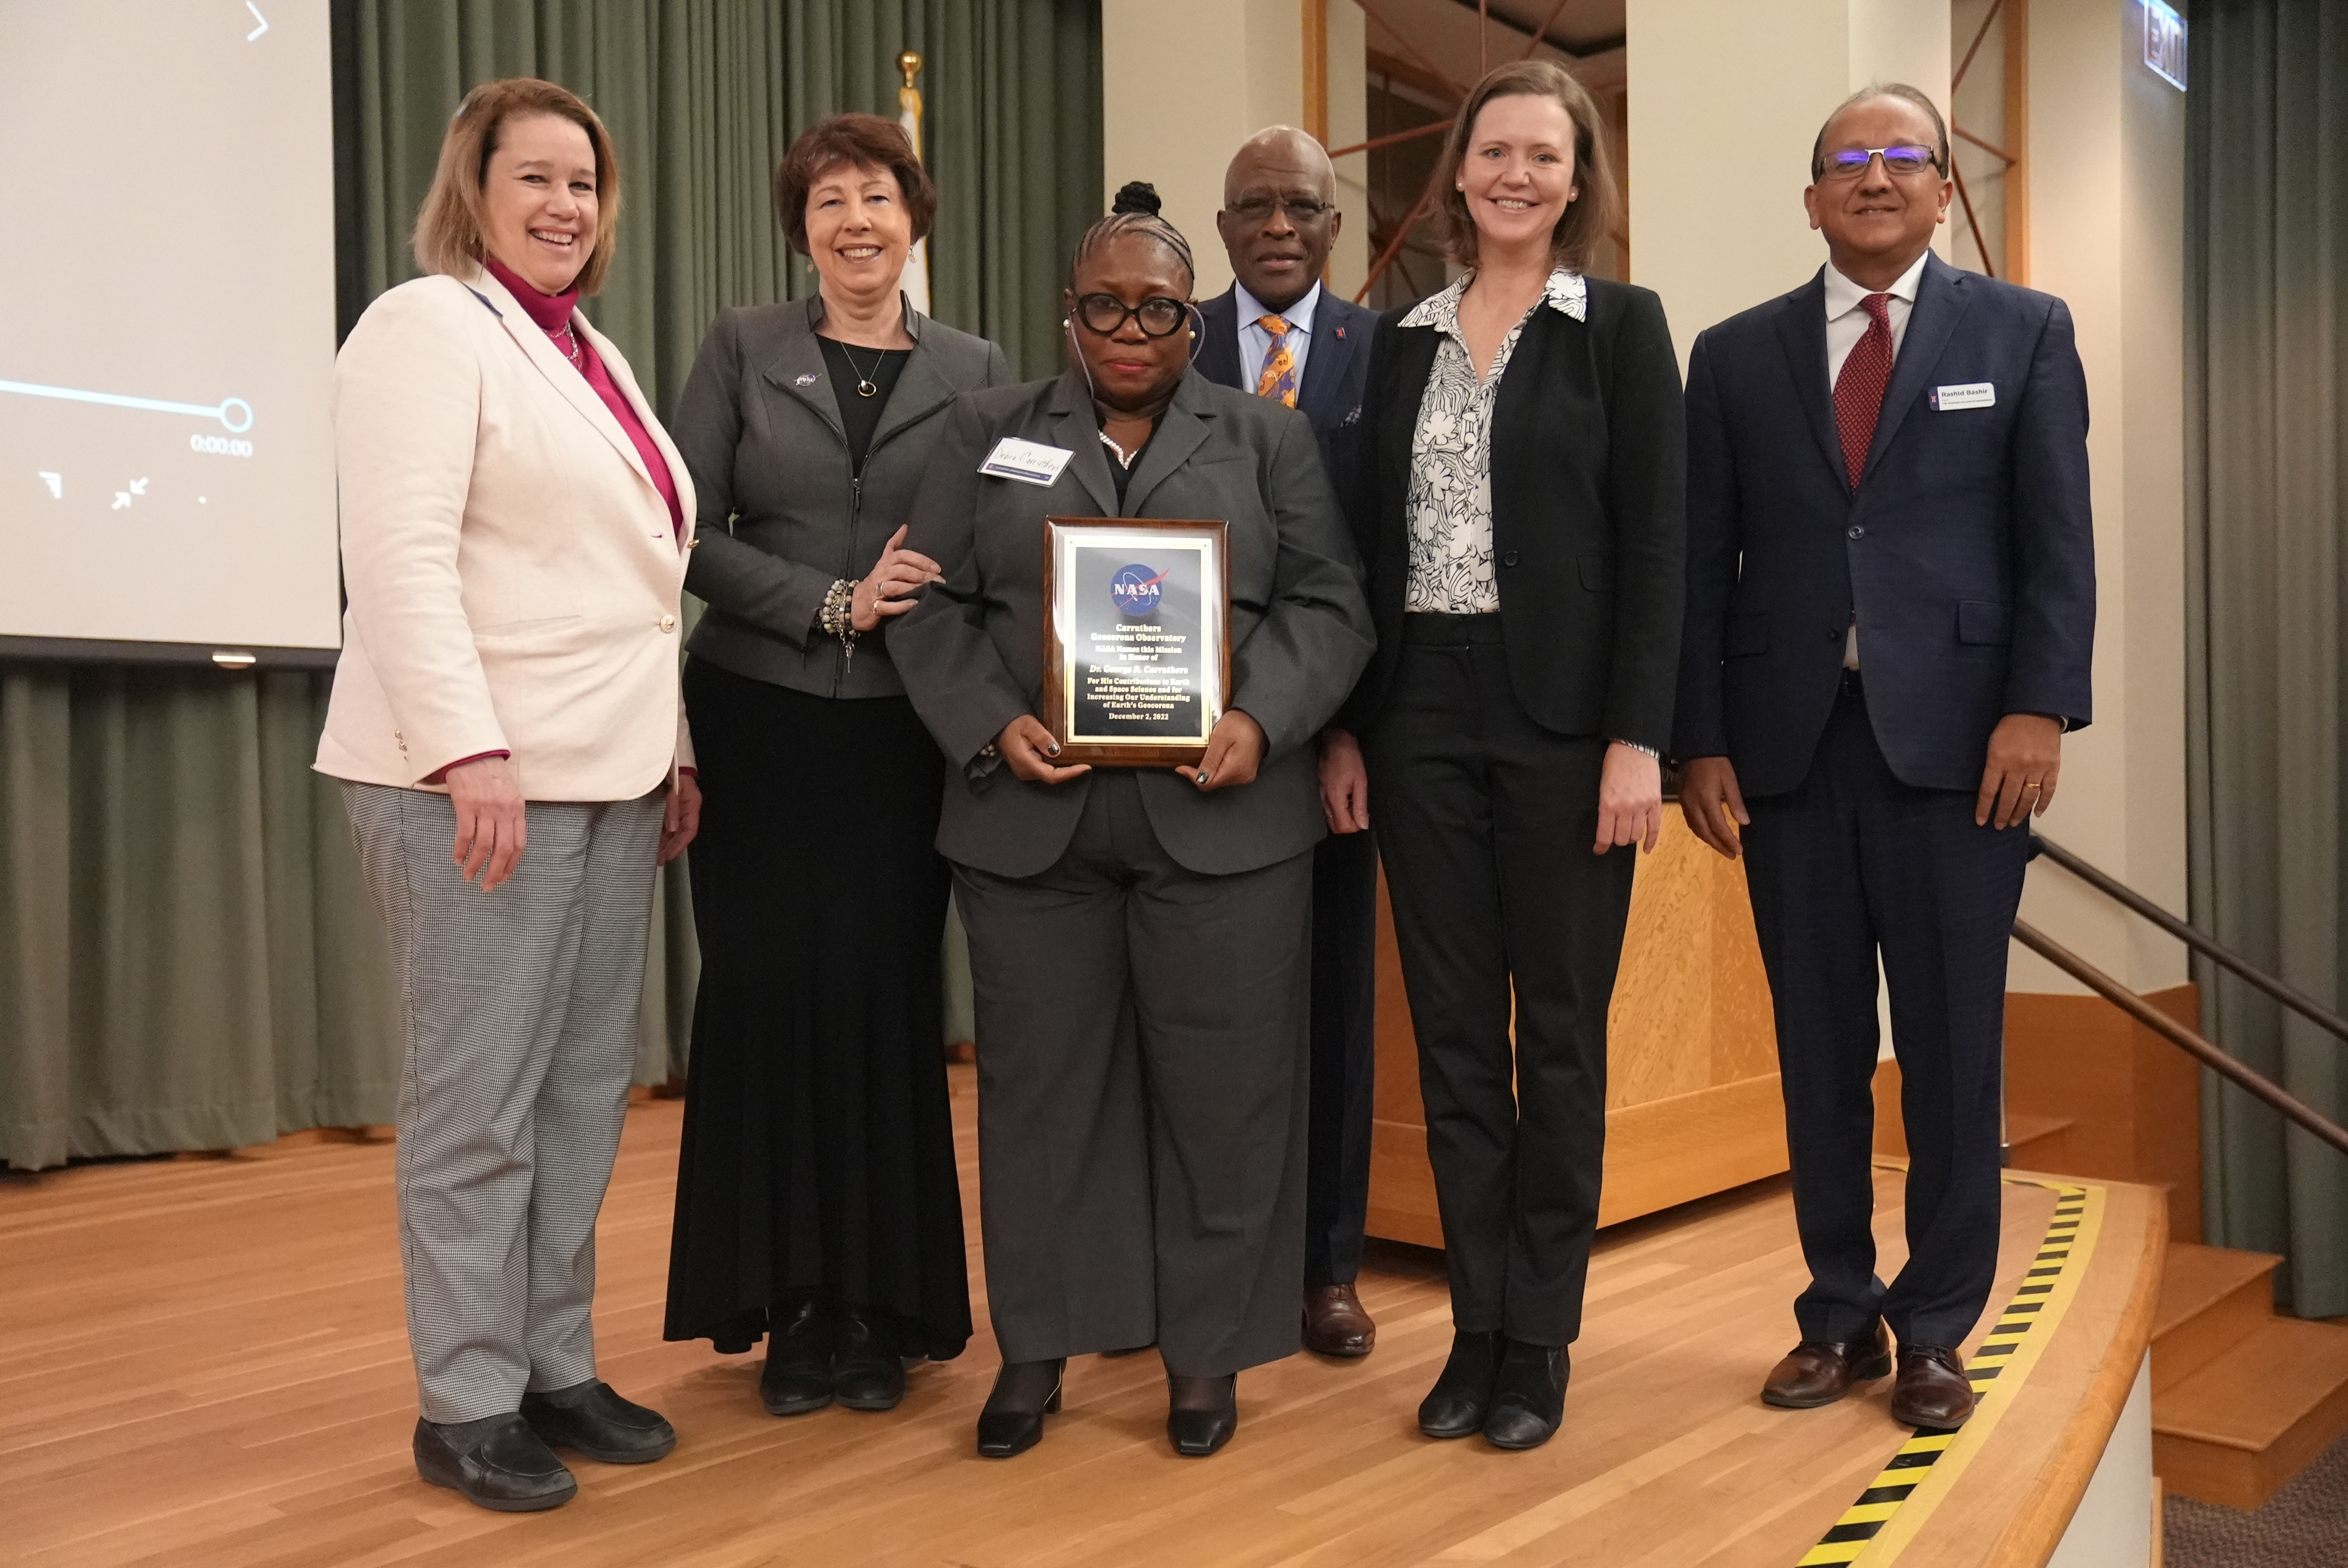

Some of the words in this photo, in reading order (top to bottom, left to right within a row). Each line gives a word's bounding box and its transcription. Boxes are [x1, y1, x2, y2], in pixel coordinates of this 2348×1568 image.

[190, 434, 254, 457] 0:00:00
[1114, 584, 1160, 595] NASA
[1090, 633, 1134, 641] Geocorona
[1136, 634, 1186, 643] Observatory
[1104, 665, 1131, 674] George
